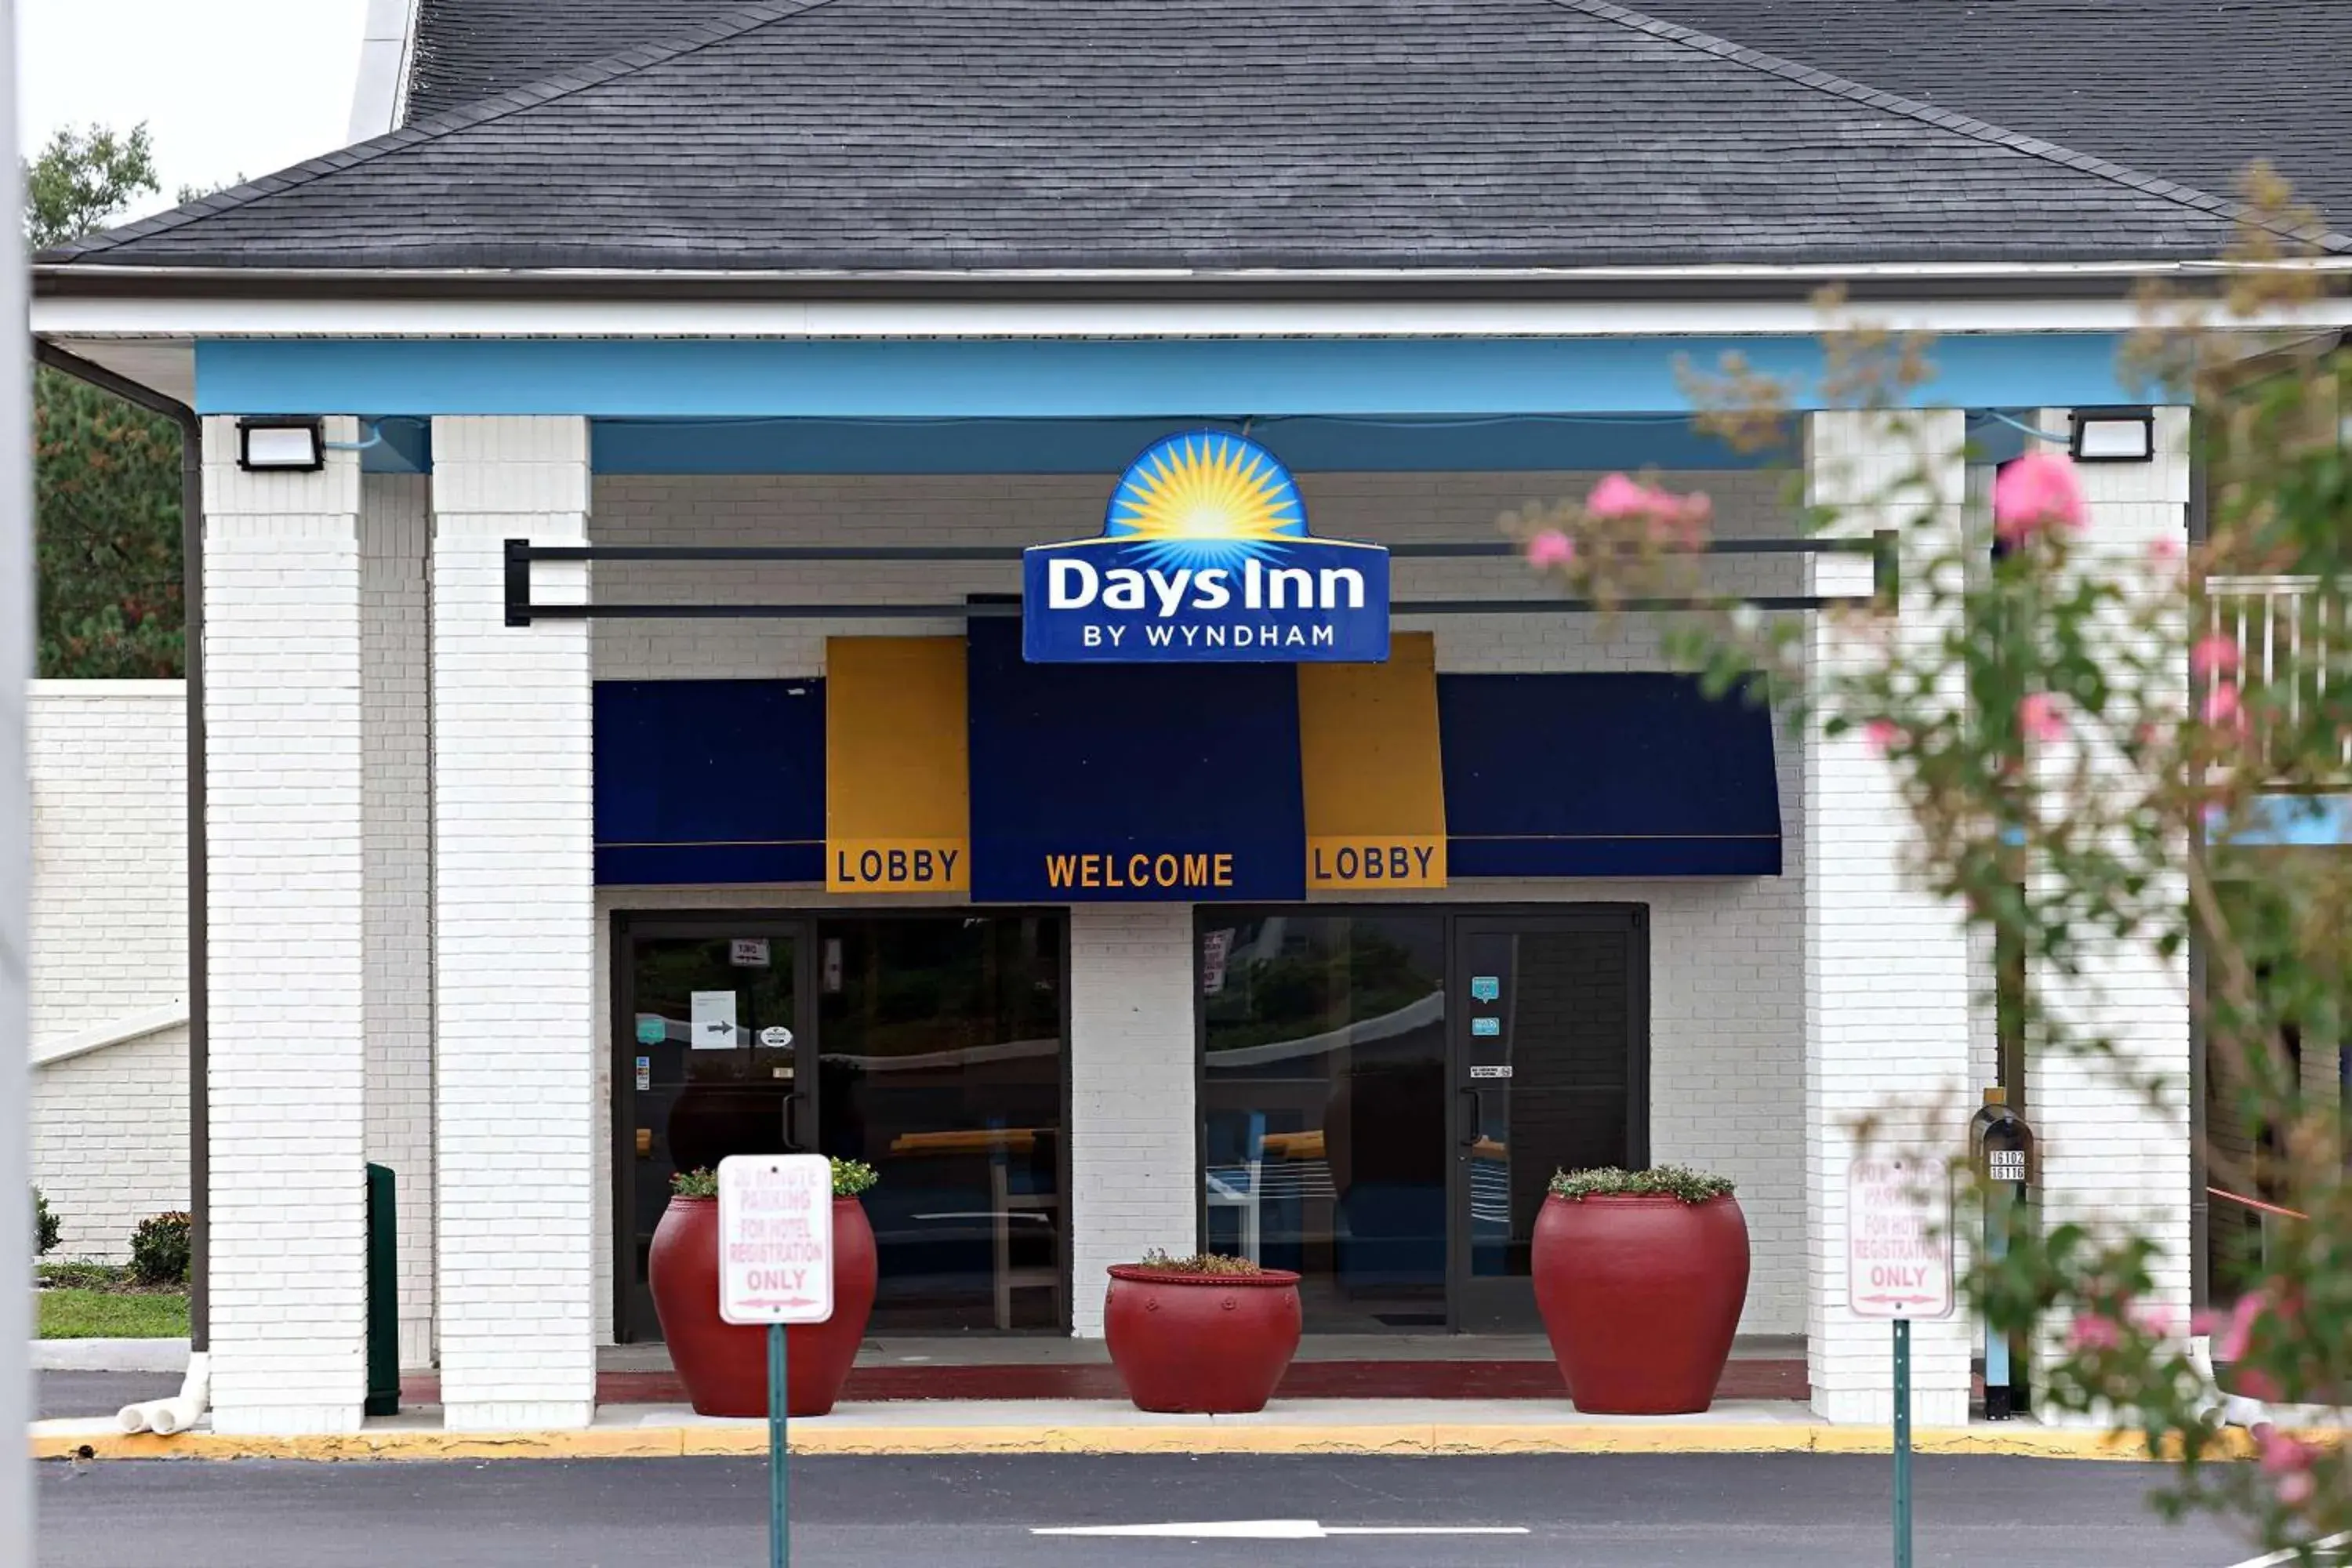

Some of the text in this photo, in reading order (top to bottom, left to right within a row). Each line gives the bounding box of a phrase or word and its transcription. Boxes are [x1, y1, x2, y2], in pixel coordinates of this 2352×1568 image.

[1048, 558, 1364, 618] Days Inn
[1083, 625, 1334, 647] BY WYNDHAM
[838, 850, 960, 882] LOBBY
[1047, 853, 1234, 887] WELCOME
[1314, 846, 1435, 880] LOBBY
[1992, 1152, 2024, 1164] 16102
[1992, 1167, 2024, 1178] 16116
[1892, 1214, 1929, 1235] HOTE
[747, 1269, 807, 1291] ONLY
[1870, 1266, 1928, 1287] ONLY
